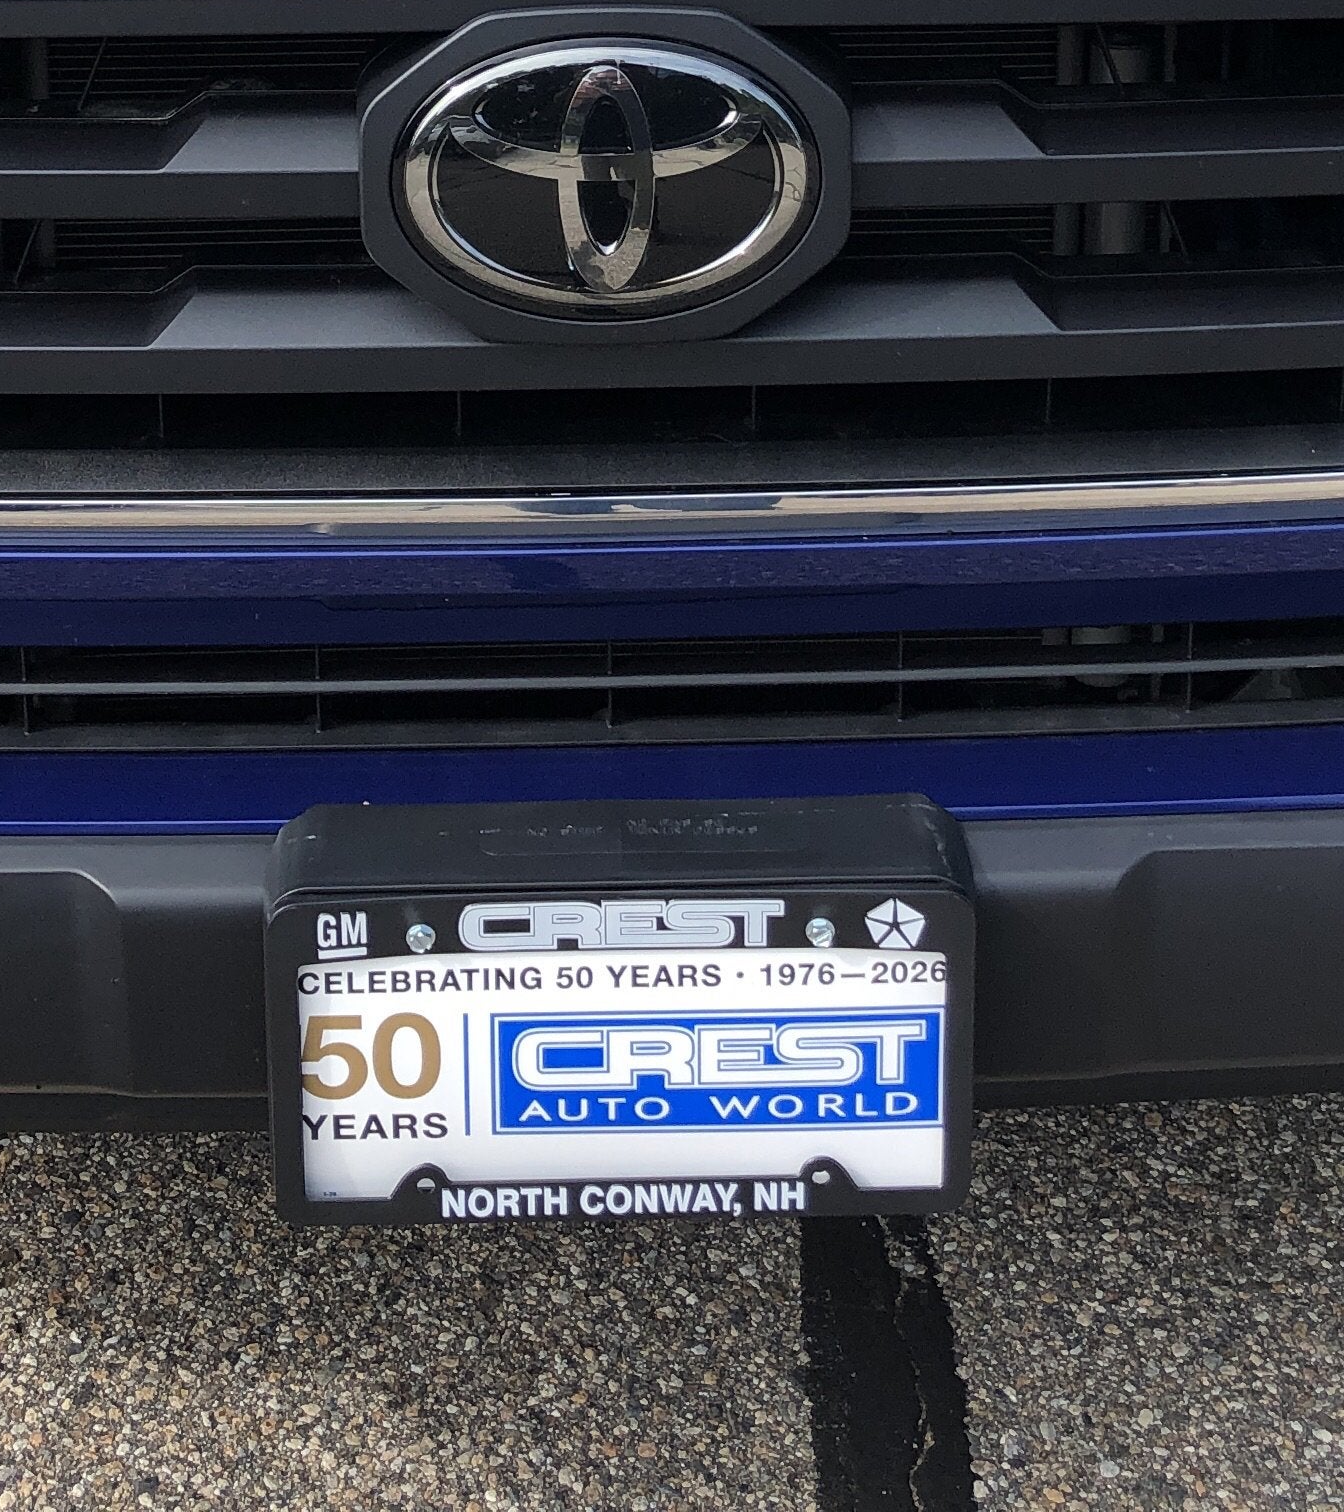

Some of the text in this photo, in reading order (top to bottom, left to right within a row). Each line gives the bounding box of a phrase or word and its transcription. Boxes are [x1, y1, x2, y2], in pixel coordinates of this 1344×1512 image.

[317, 911, 368, 948] GM
[458, 900, 784, 950] CREST
[298, 967, 542, 994] CELEBRATING
[556, 967, 594, 989] 50
[608, 963, 722, 989] YEARS
[302, 1012, 442, 1100] 50
[512, 1020, 927, 1090] CREST
[519, 1092, 919, 1122] AUTO WORLD
[303, 1113, 449, 1140] YEARS
[441, 1182, 806, 1218] NORTH CONWAY, NH
